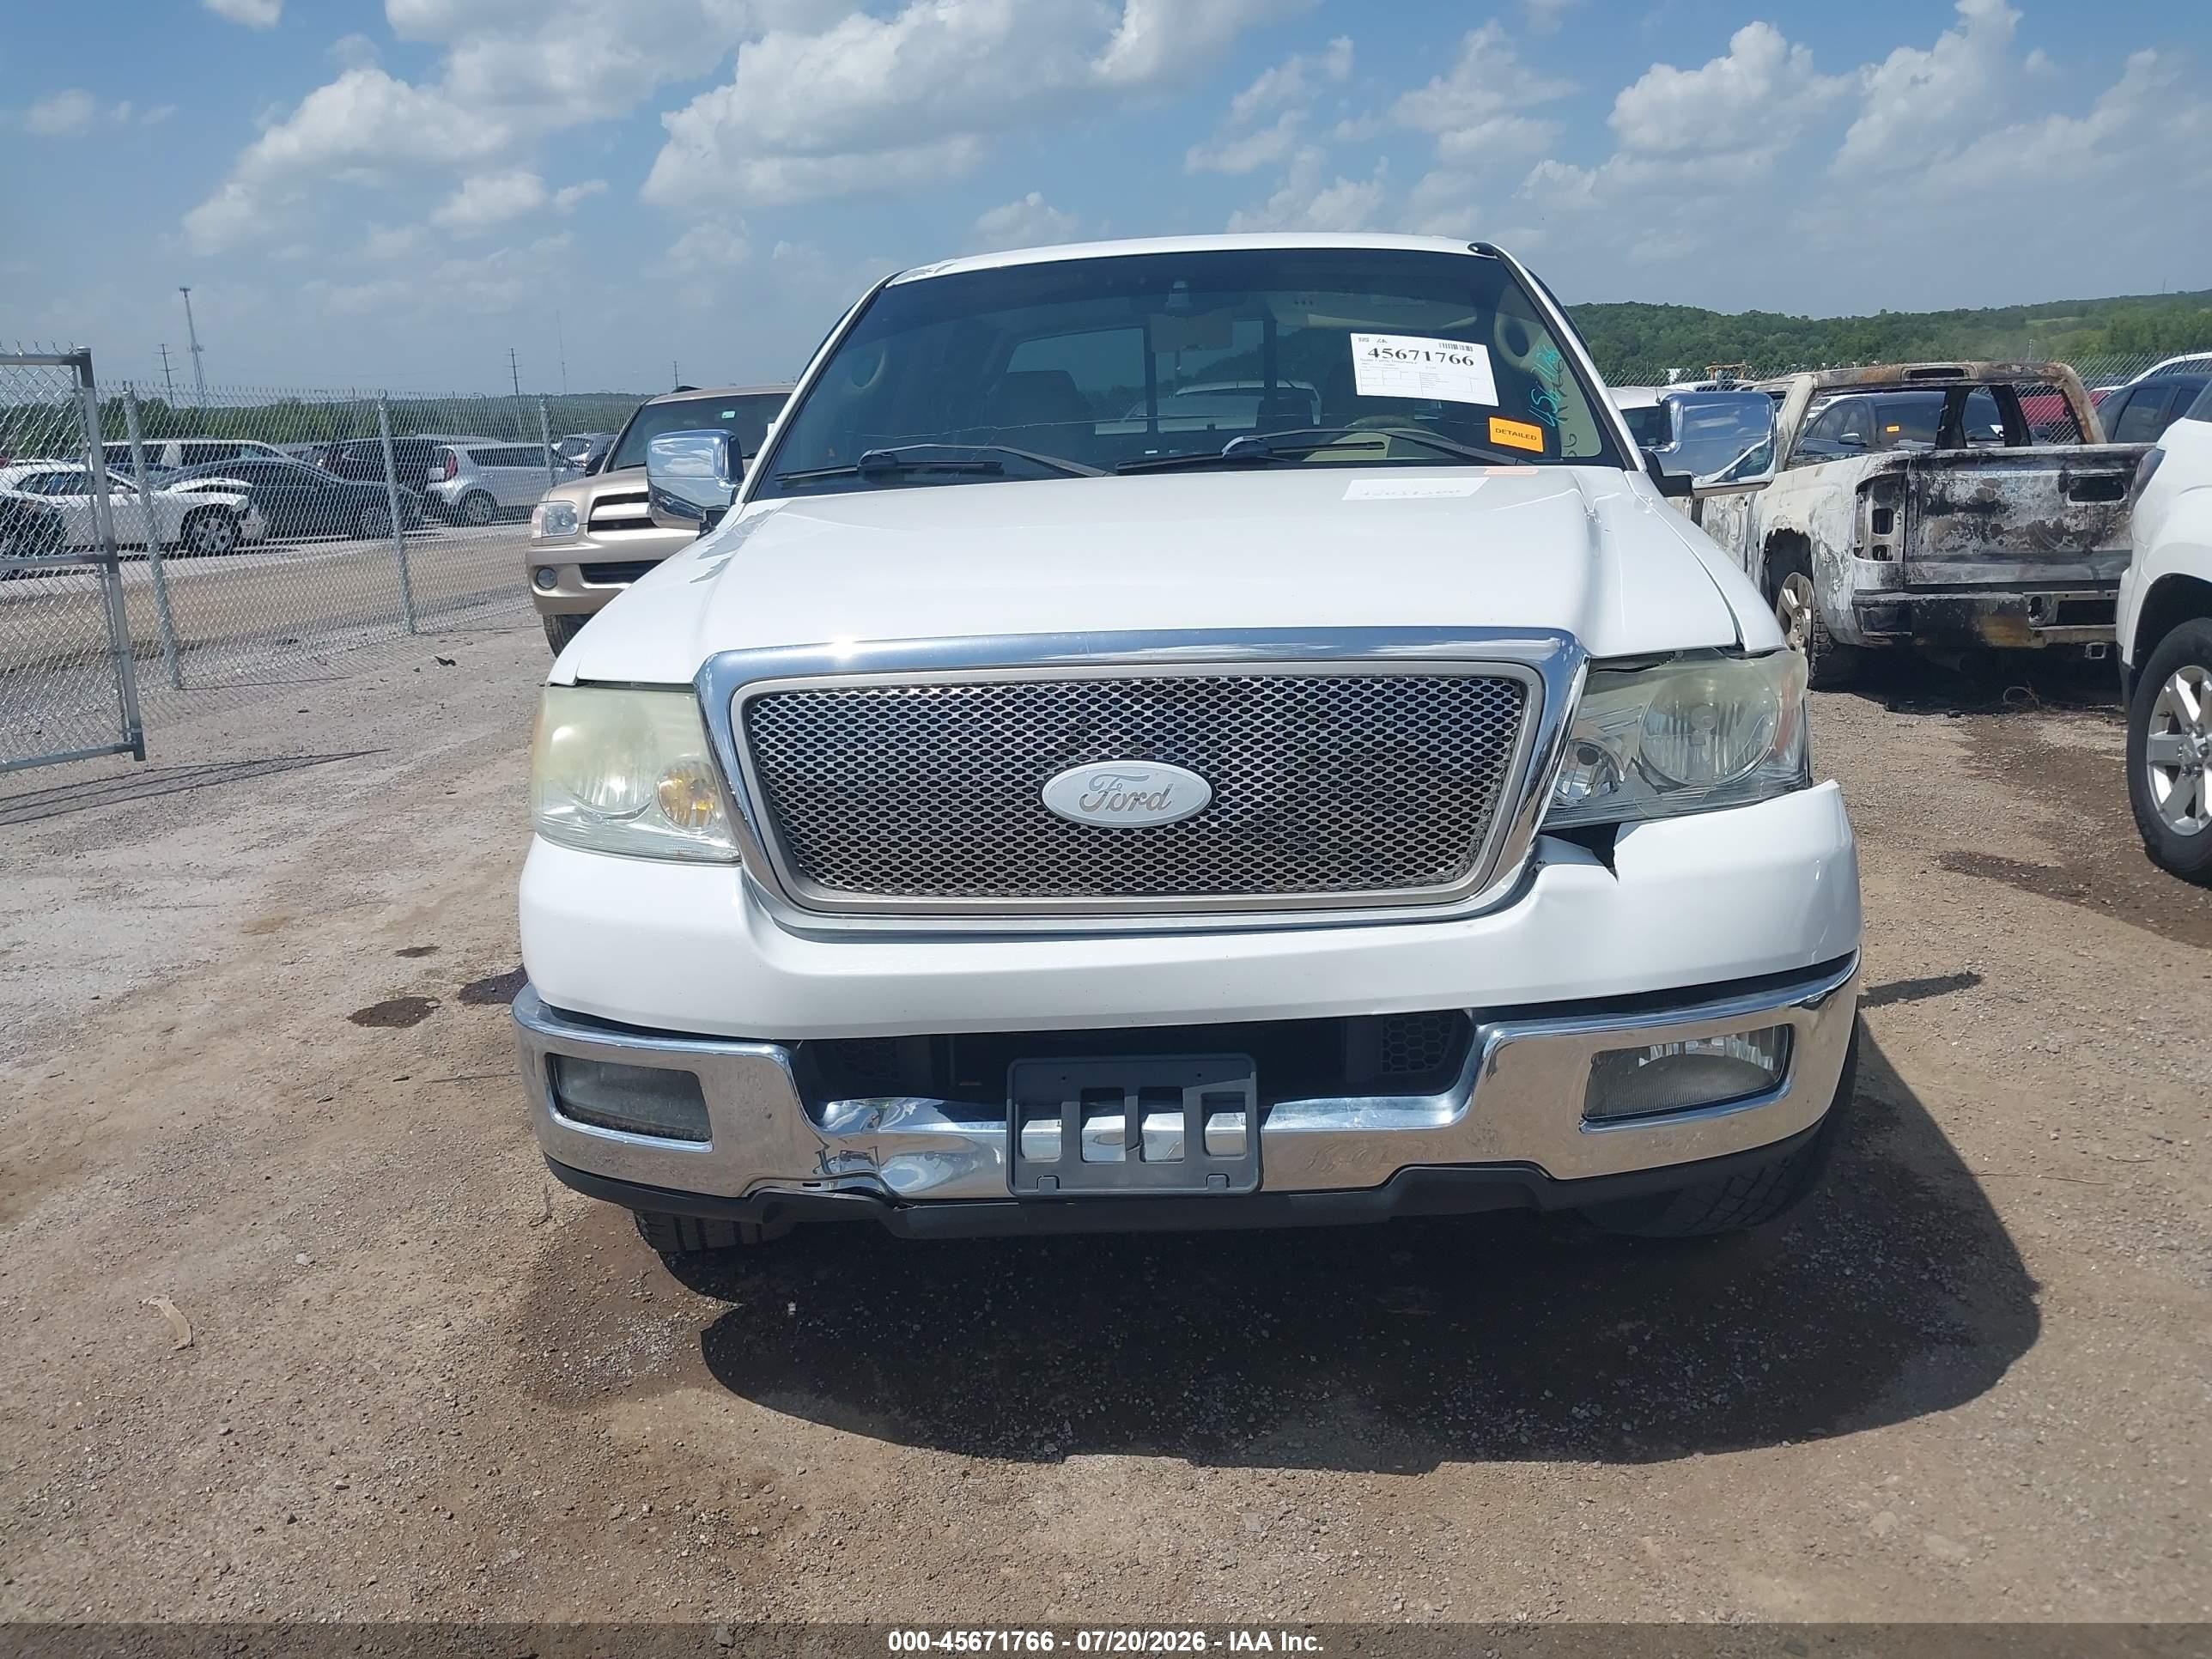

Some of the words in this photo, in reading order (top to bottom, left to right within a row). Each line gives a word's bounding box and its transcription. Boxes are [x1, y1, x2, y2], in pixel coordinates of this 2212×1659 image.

[1367, 348, 1474, 367] 45671766
[1495, 428, 1537, 441] DETAILED
[1079, 773, 1175, 812] Ford
